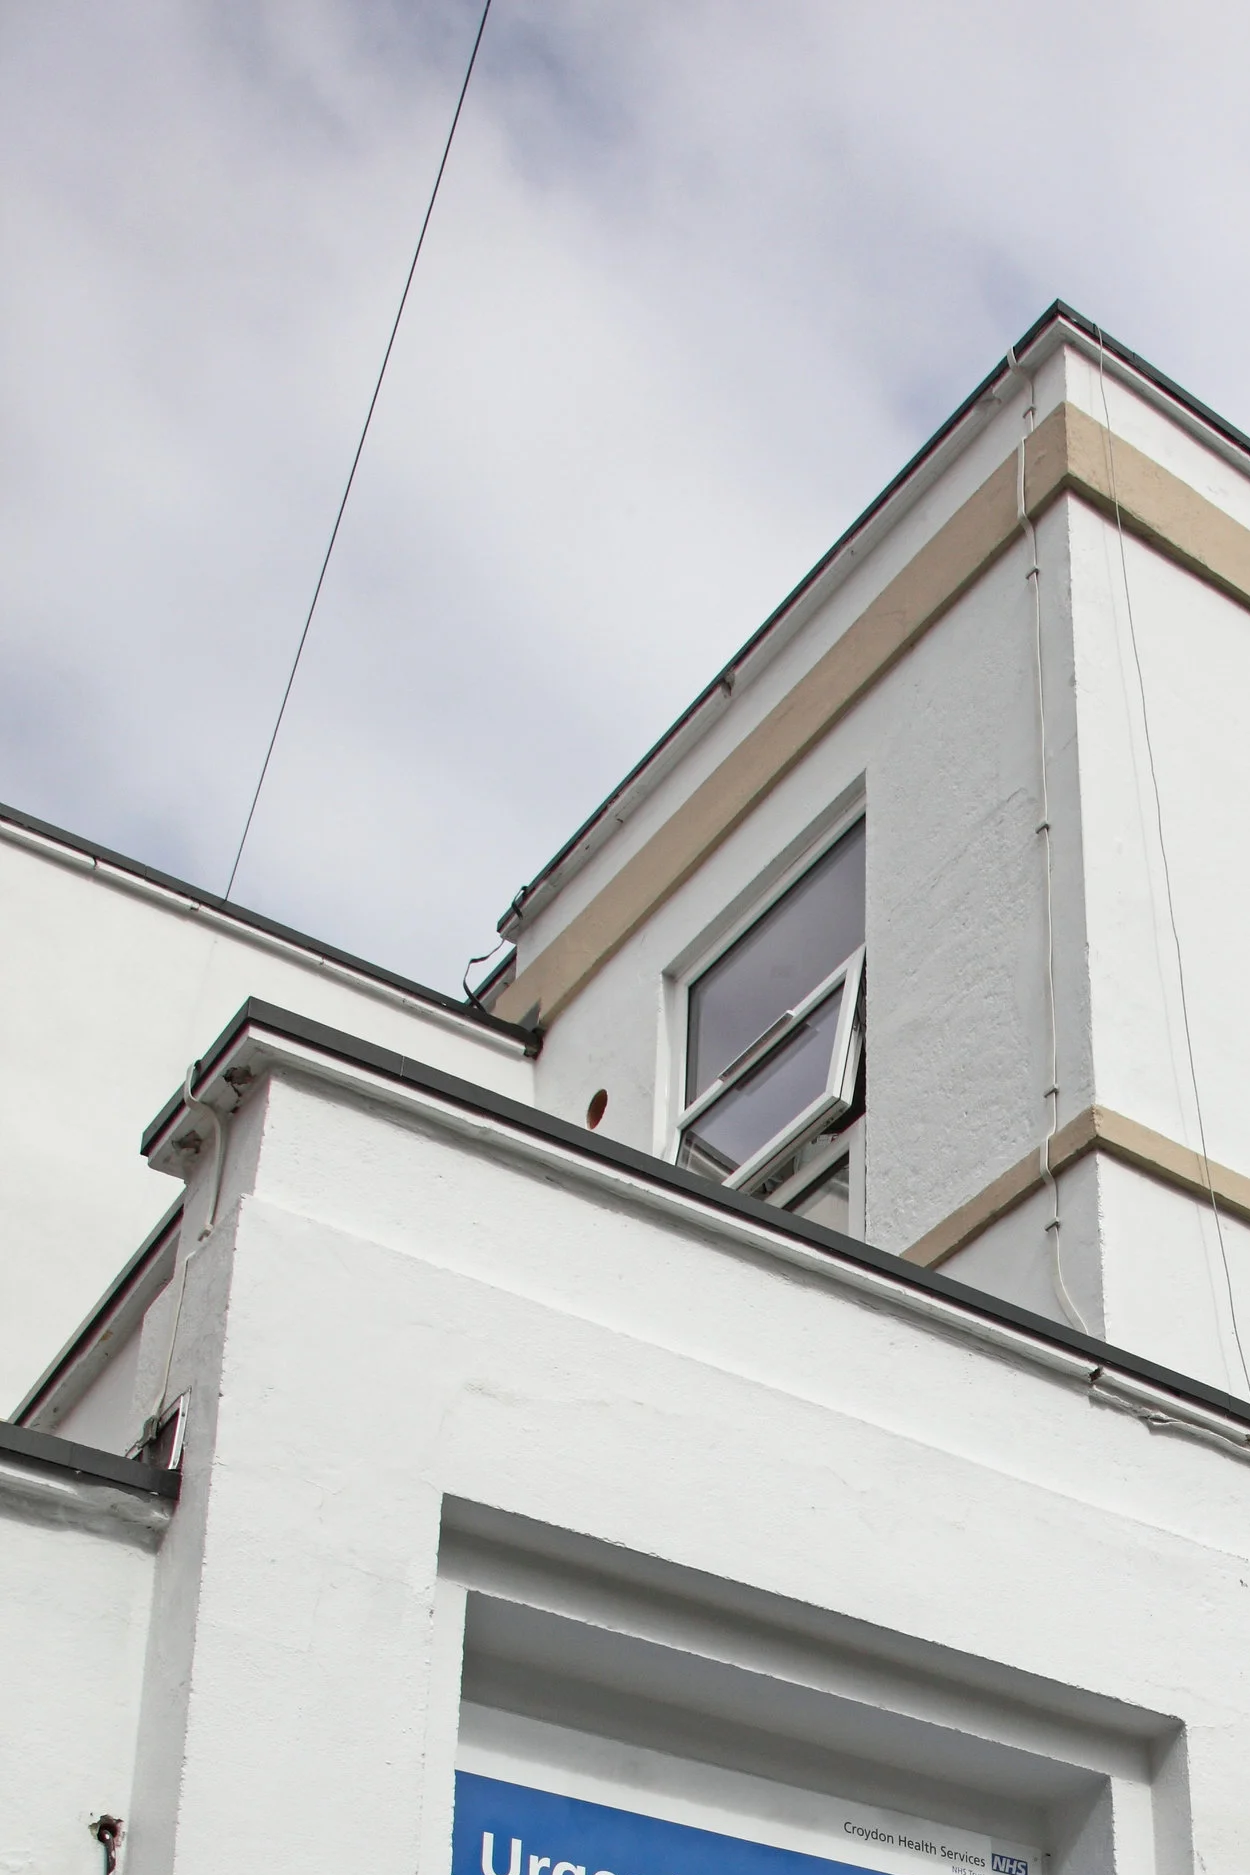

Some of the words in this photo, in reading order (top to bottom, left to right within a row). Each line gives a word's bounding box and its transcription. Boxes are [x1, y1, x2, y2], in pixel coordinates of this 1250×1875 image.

[843, 1821, 894, 1844] Croydon
[898, 1835, 937, 1855] Health
[940, 1846, 986, 1867] Services
